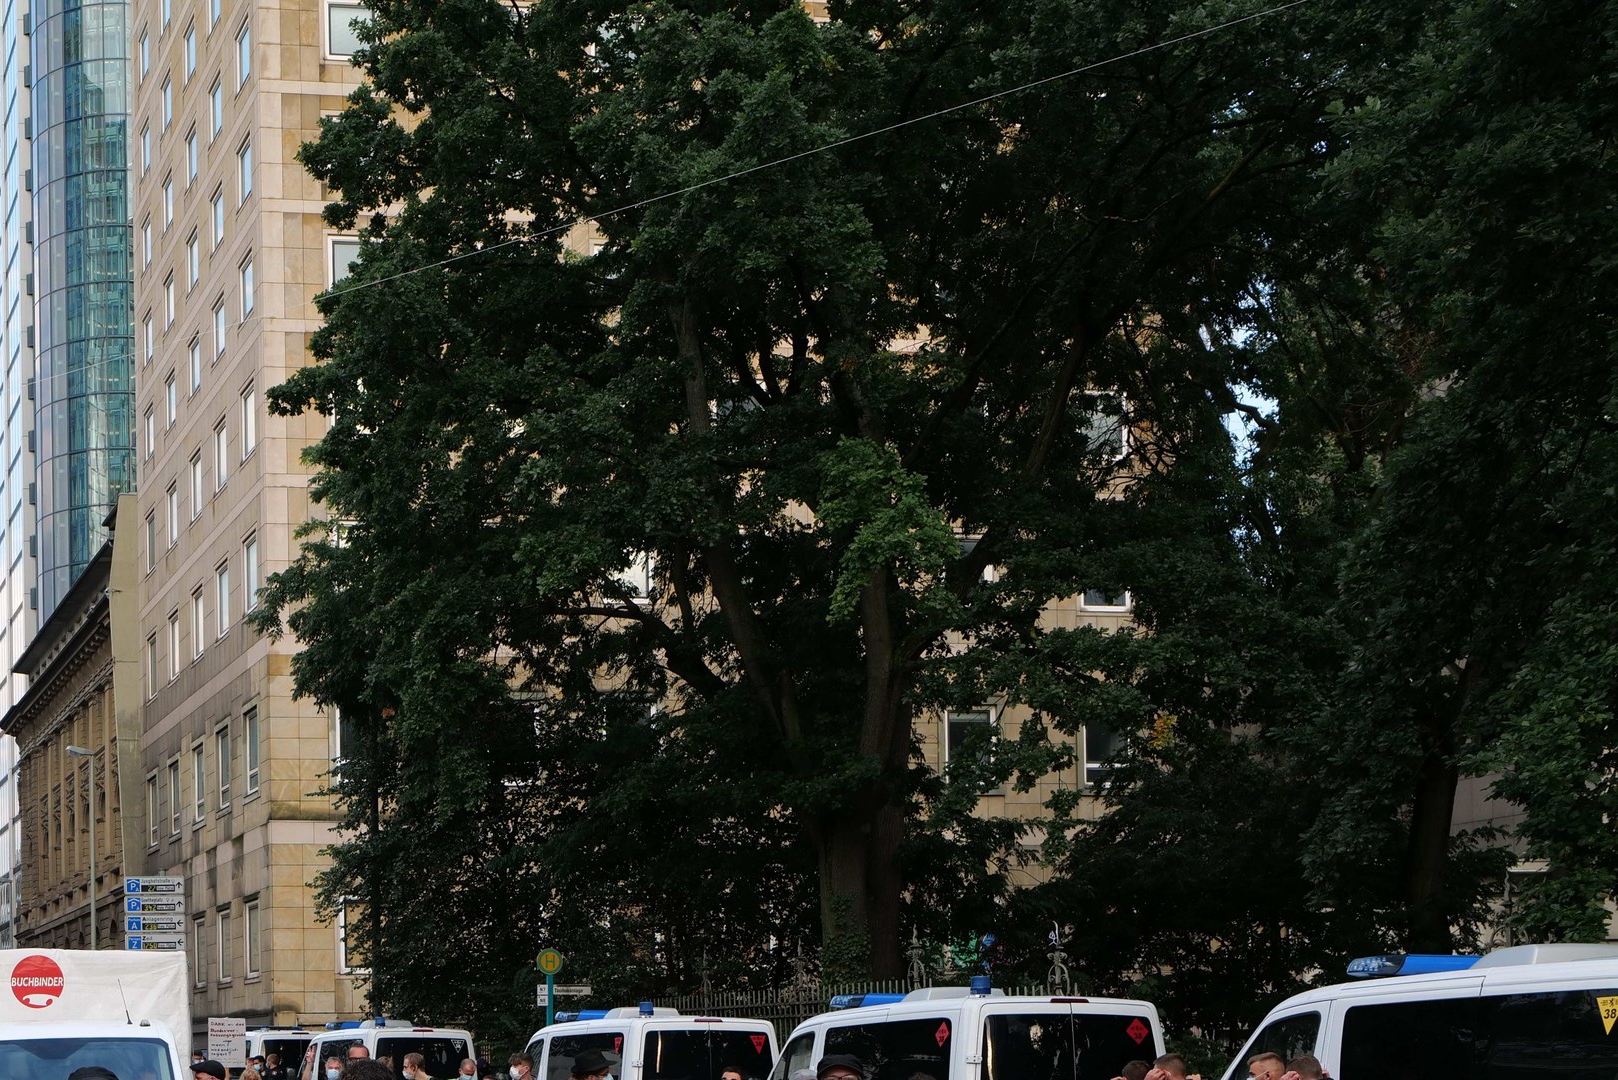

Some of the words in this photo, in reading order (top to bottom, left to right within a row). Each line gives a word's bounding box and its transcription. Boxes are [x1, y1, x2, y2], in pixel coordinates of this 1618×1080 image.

[545, 954, 555, 969] H
[11, 977, 64, 987] BUCHBINDER
[1603, 1008, 1617, 1019] 38
